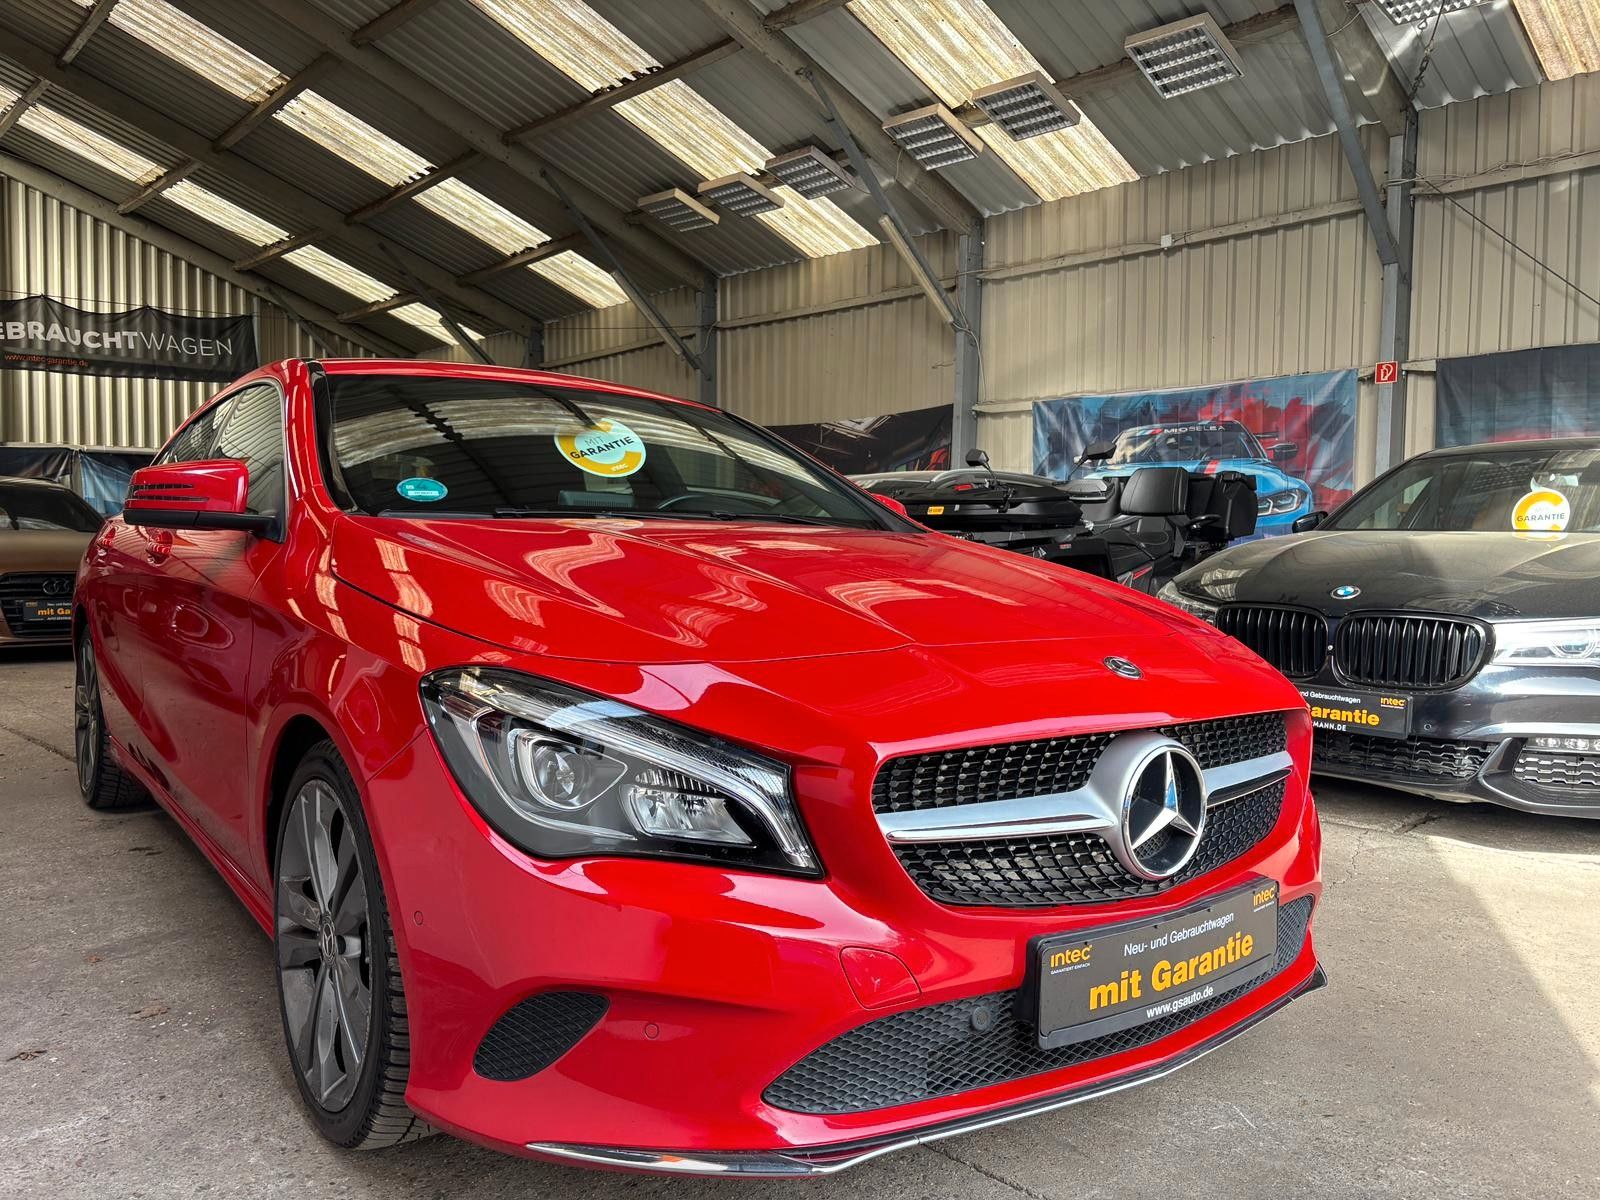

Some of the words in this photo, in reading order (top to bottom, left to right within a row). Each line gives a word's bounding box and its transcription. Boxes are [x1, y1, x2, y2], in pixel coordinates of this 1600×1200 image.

[570, 436, 634, 459] GARANTIE
[584, 436, 604, 447] MIT
[1516, 512, 1565, 522] GARANTIE
[38, 608, 54, 616] mit
[1310, 691, 1361, 704] Gebrauchtwagen
[1381, 697, 1405, 706] intec
[1311, 706, 1380, 726] arantie
[1253, 886, 1275, 906] intec
[1124, 944, 1148, 957] Neu-
[1150, 934, 1168, 950] und
[1170, 912, 1234, 942] Gebrauchtwagen
[1050, 946, 1091, 968] intec
[1089, 967, 1142, 1011] mit
[1152, 932, 1254, 992] Garantie
[1146, 986, 1214, 1018] www.gsauto.de
